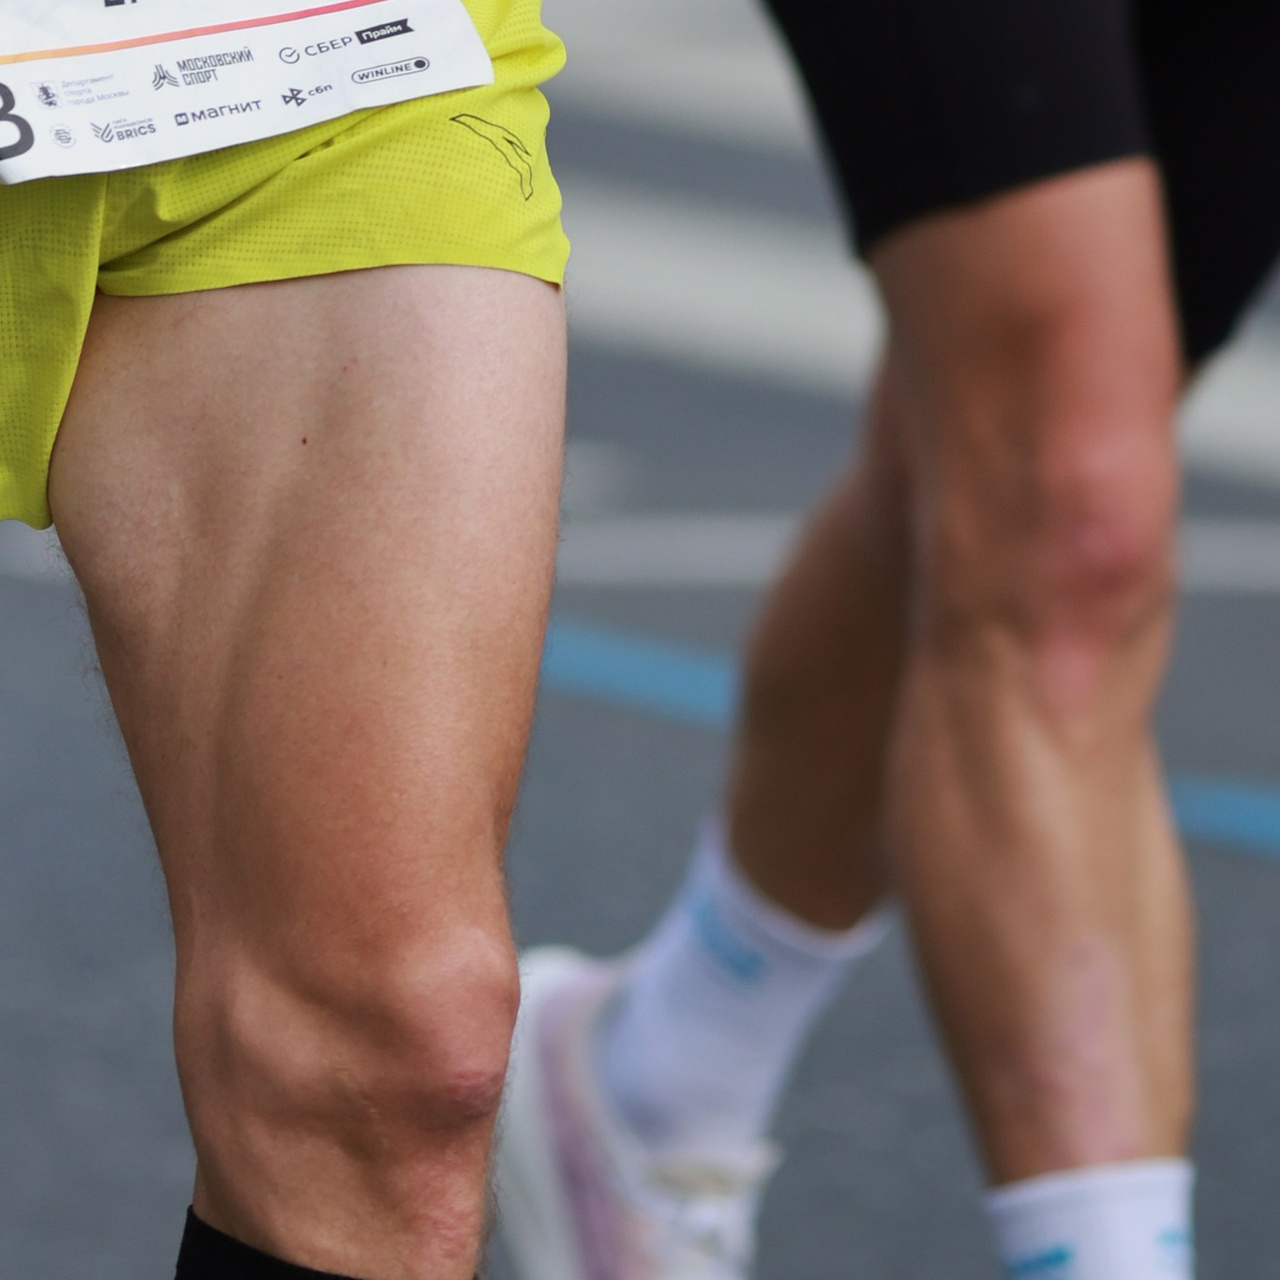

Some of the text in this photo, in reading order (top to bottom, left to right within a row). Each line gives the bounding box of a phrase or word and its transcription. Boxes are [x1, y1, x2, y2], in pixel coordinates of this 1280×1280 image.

[304, 23, 403, 58] СБЕР Прайм
[176, 46, 254, 73] МОСКОВСКИЙ
[182, 69, 219, 87] СПОРТ
[357, 62, 413, 82] WINLINE
[116, 124, 157, 142] BRICS
